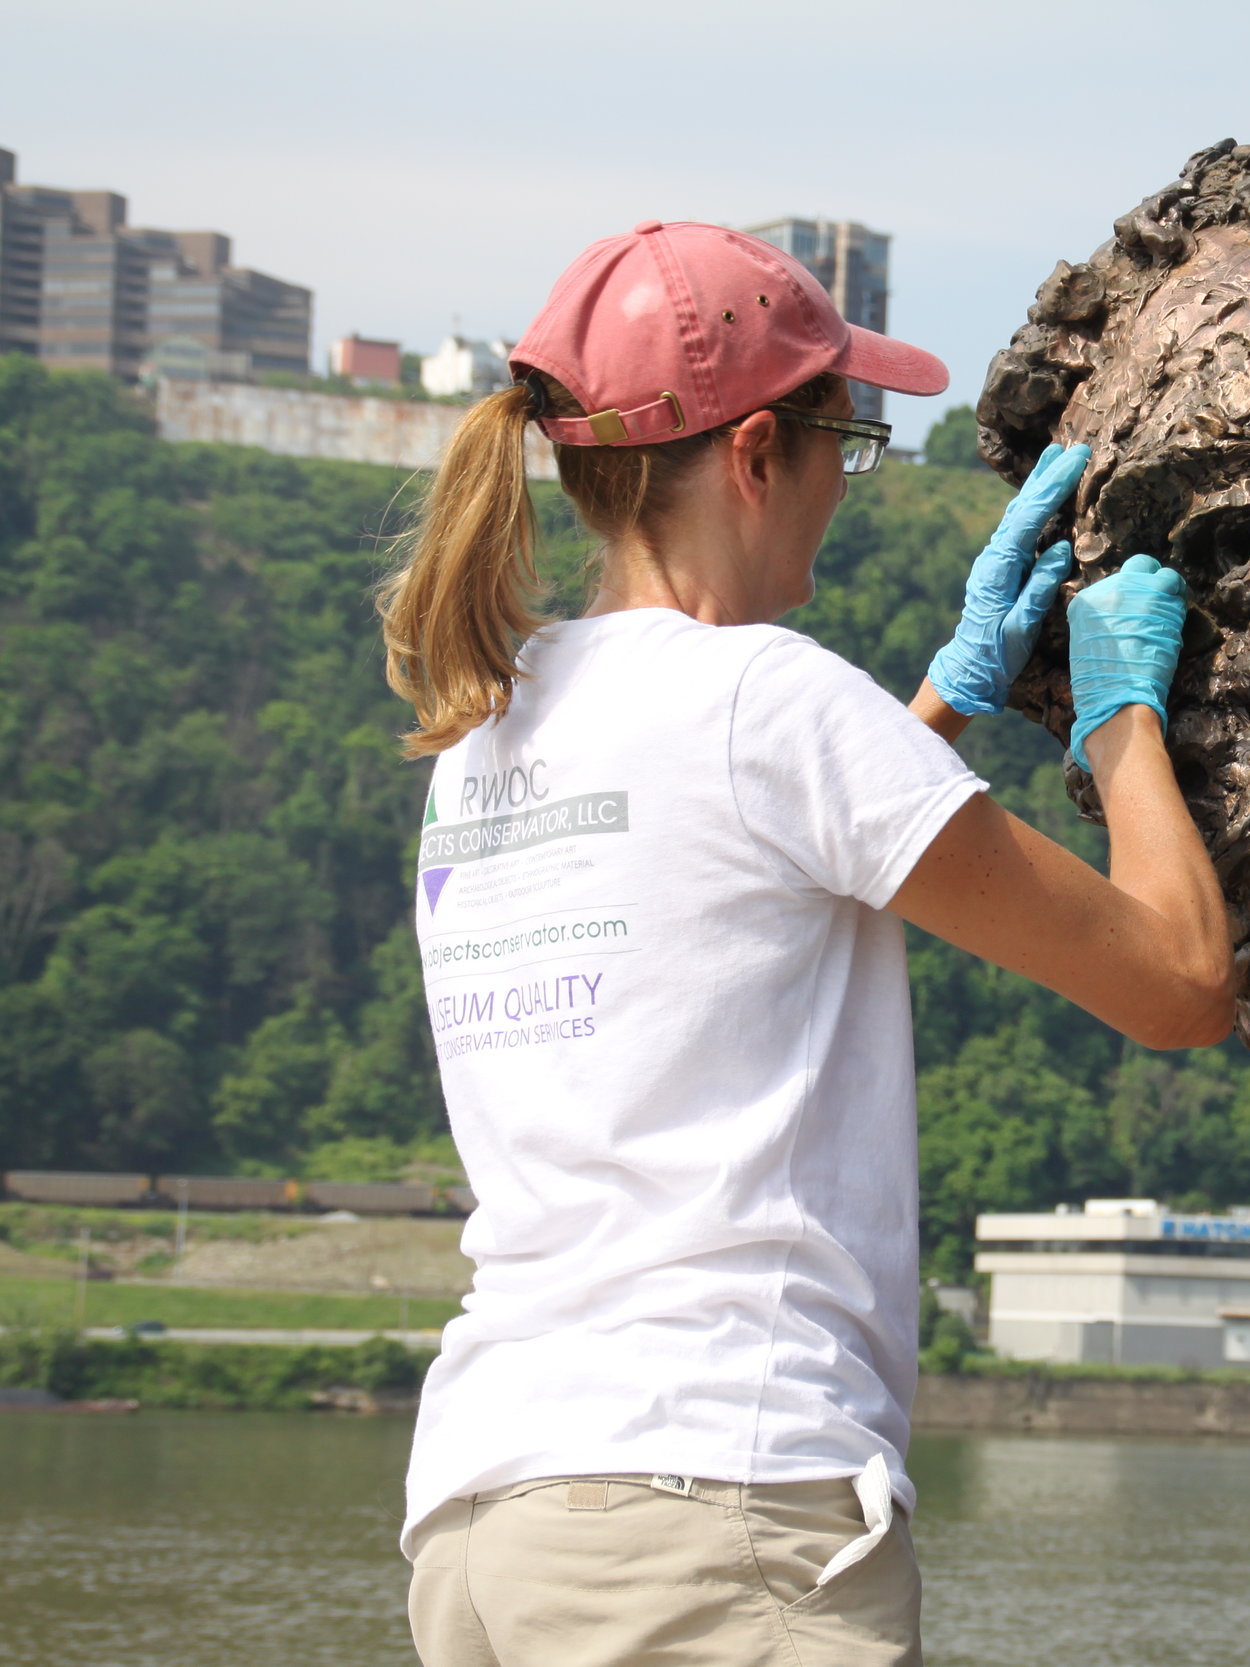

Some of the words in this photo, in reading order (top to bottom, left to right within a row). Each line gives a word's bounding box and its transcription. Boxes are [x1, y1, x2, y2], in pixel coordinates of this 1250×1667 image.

[460, 758, 549, 817] RWOC
[459, 807, 572, 854] CONSERVATOR,
[578, 800, 618, 826] LLC
[561, 858, 594, 871] MATERIAL
[504, 972, 603, 1022] QUALITY
[444, 1027, 531, 1060] CONSERVATION
[533, 1016, 596, 1045] SERVICES
